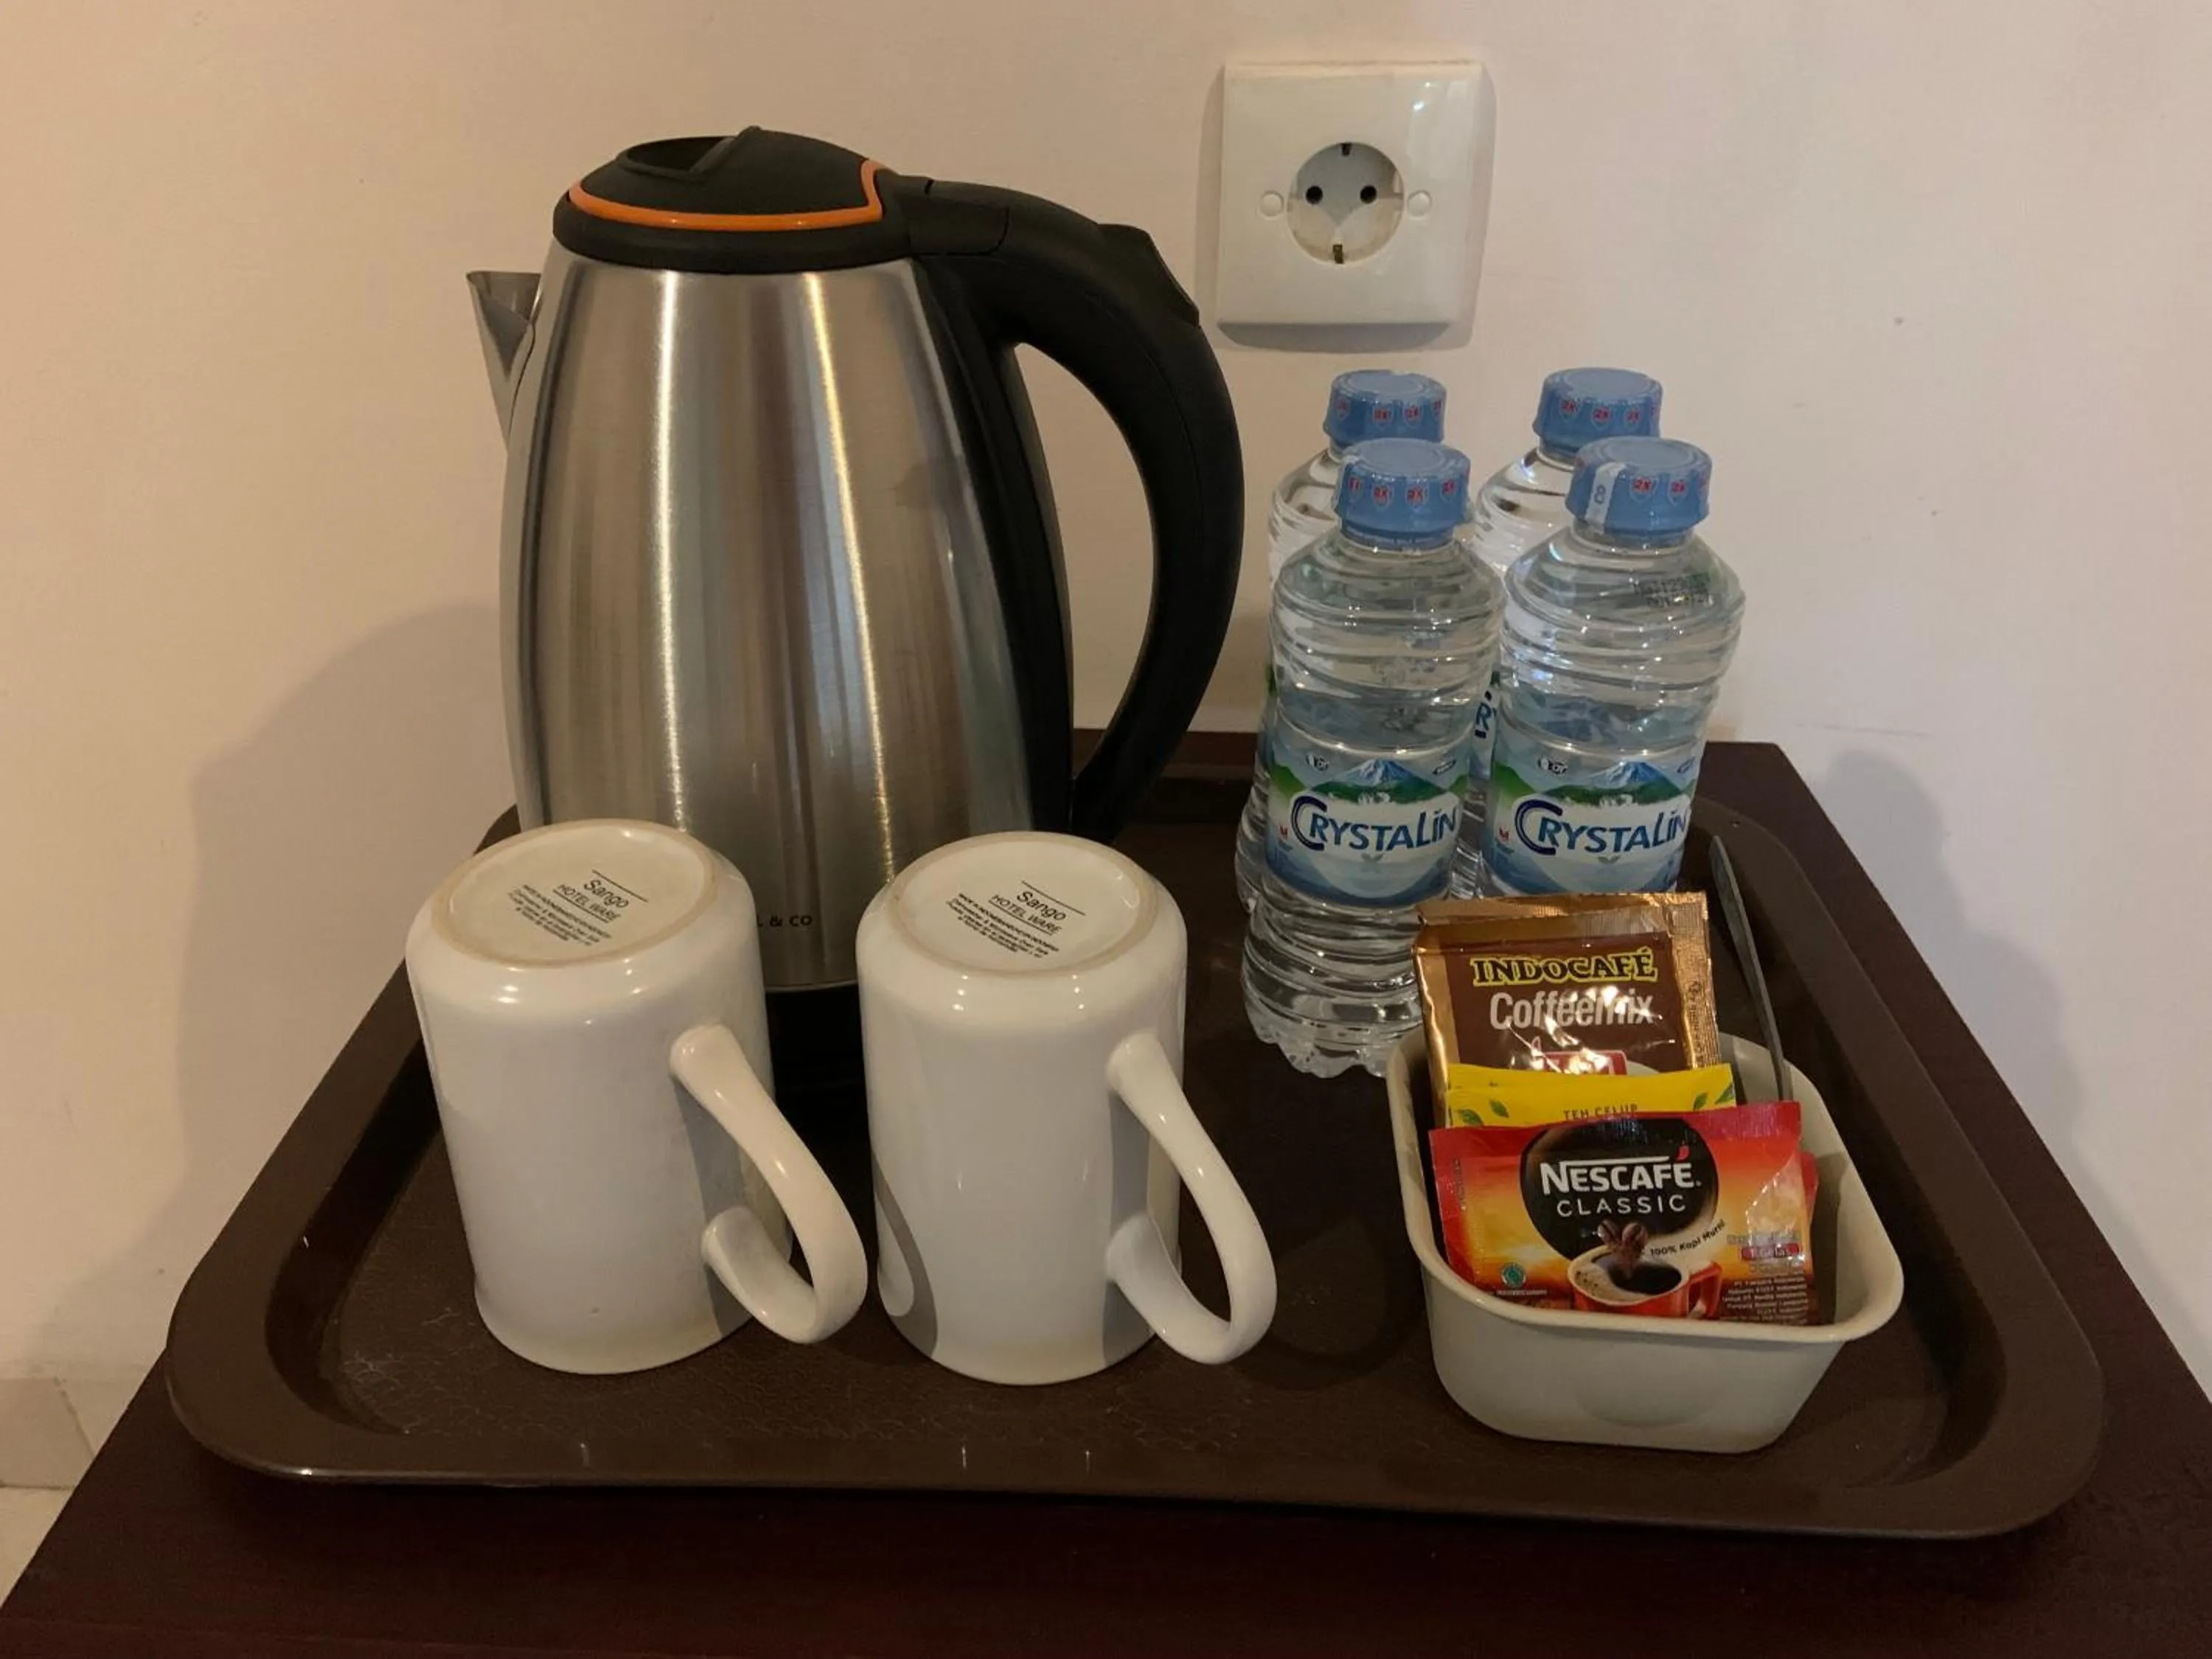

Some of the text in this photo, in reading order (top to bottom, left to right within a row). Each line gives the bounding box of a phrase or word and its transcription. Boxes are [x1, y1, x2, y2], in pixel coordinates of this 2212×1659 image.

[557, 884, 590, 906] HOTEL
[584, 880, 630, 908] Sango
[991, 894, 1027, 918] HOTEL
[1017, 890, 1067, 921] Sango
[769, 915, 783, 928] &
[789, 915, 813, 927] CO
[1470, 947, 1658, 987] INDOCAFÉ
[1489, 988, 1654, 1030] Coffeemix
[1557, 1194, 1686, 1217] CLASSIC
[1650, 1245, 1677, 1256] 100%
